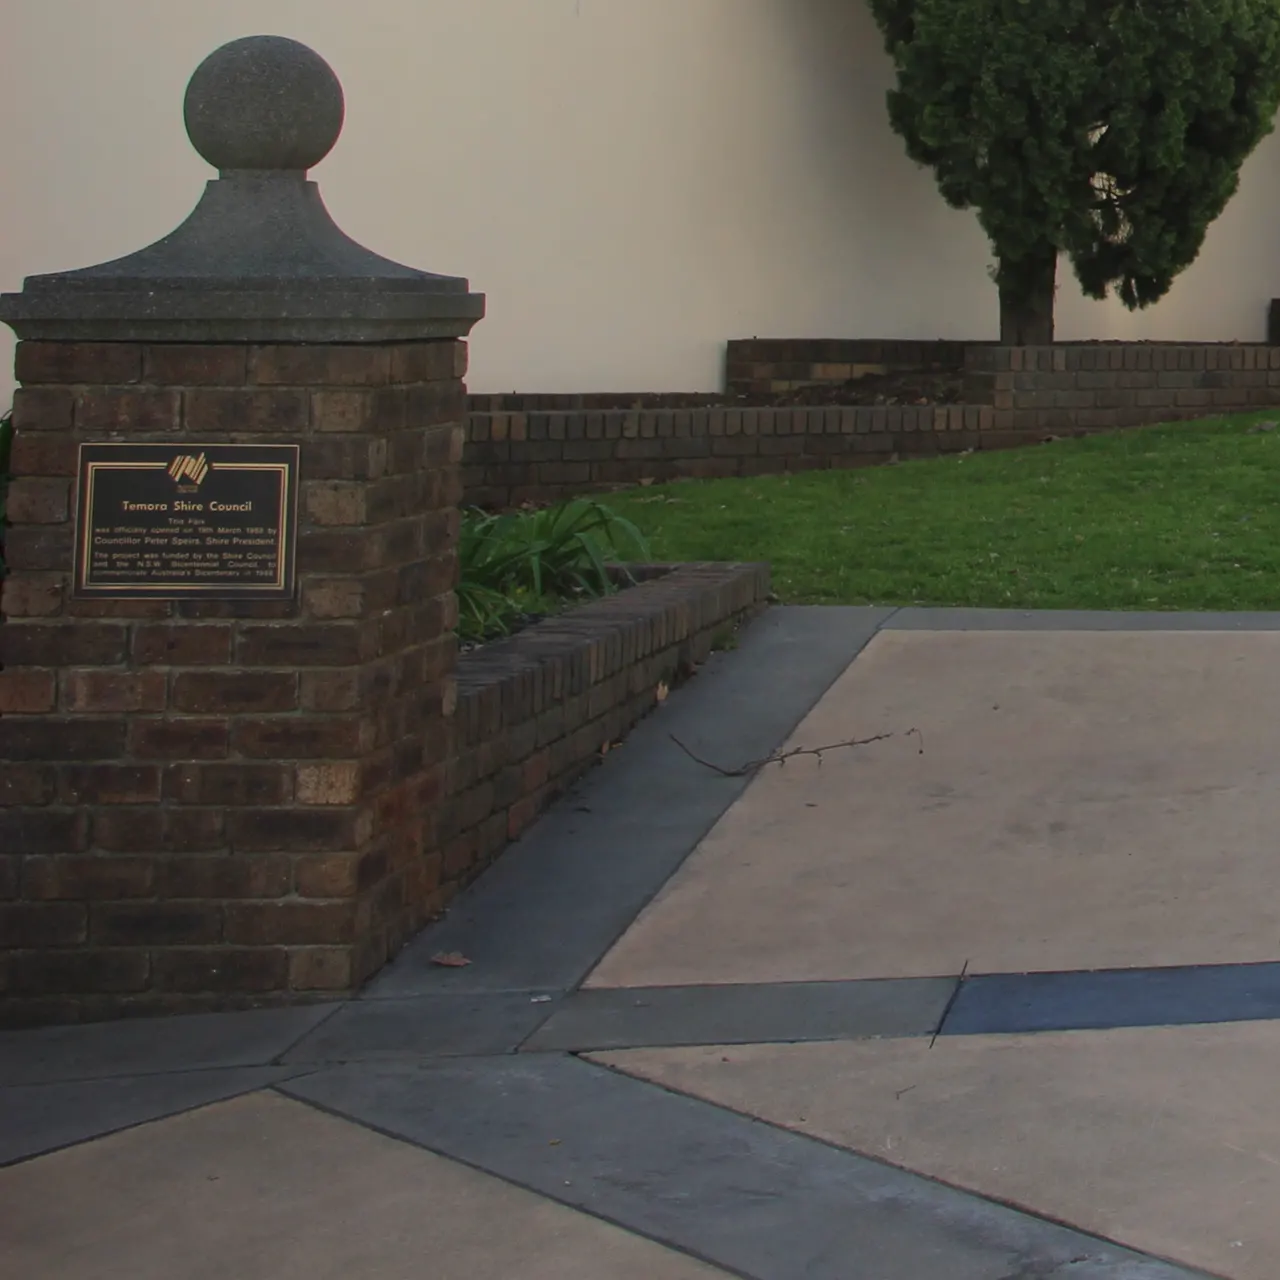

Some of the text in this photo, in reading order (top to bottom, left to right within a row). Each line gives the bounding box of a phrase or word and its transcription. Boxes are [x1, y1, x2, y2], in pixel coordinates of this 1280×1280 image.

[122, 501, 252, 511] Temora Shire Council
[94, 536, 141, 544] Councillor
[205, 537, 229, 545] Shire
